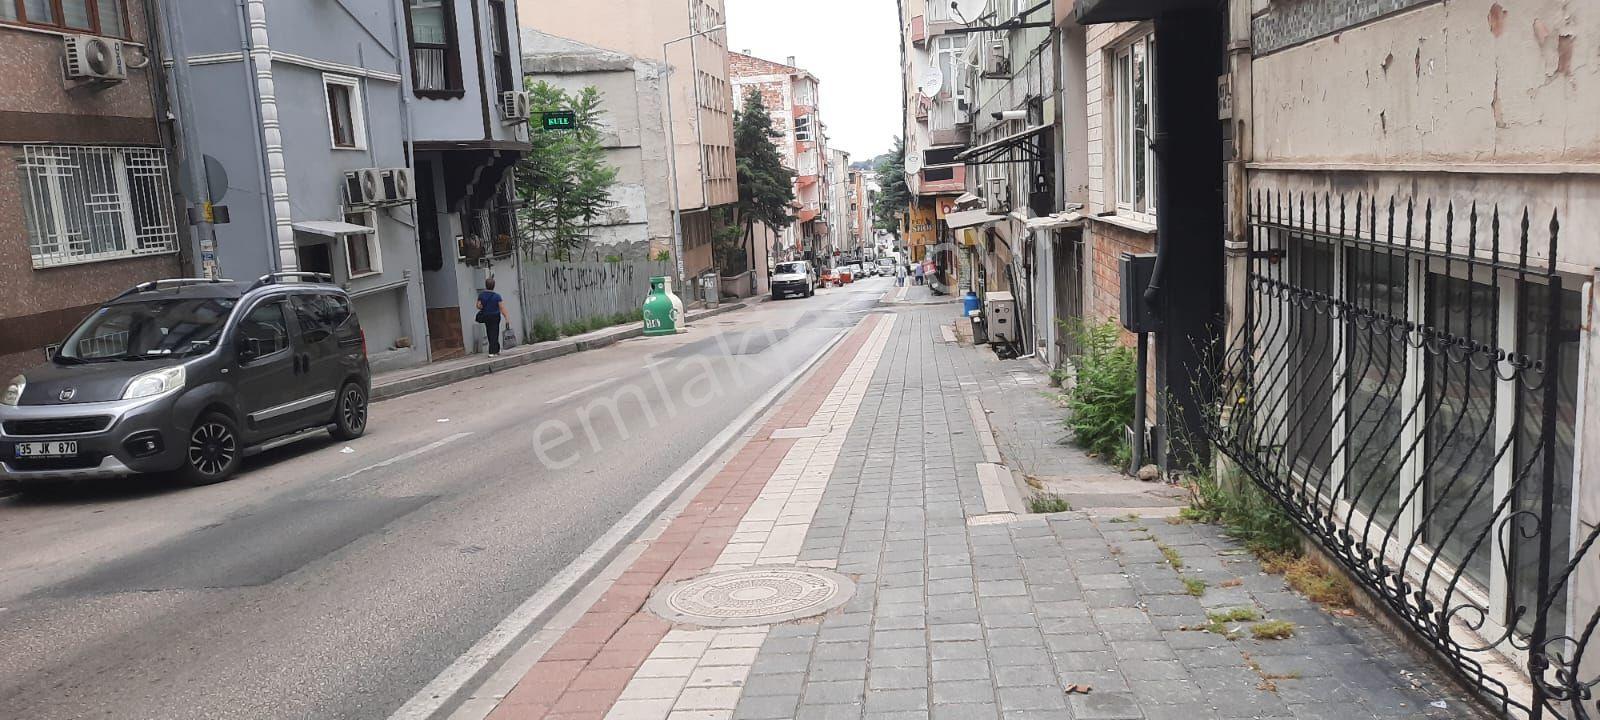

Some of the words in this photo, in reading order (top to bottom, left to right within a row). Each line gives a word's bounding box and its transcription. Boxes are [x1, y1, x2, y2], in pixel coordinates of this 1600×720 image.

[548, 118, 569, 126] KULE
[21, 444, 31, 454] 35
[39, 443, 49, 454] JK
[59, 442, 76, 453] 870
